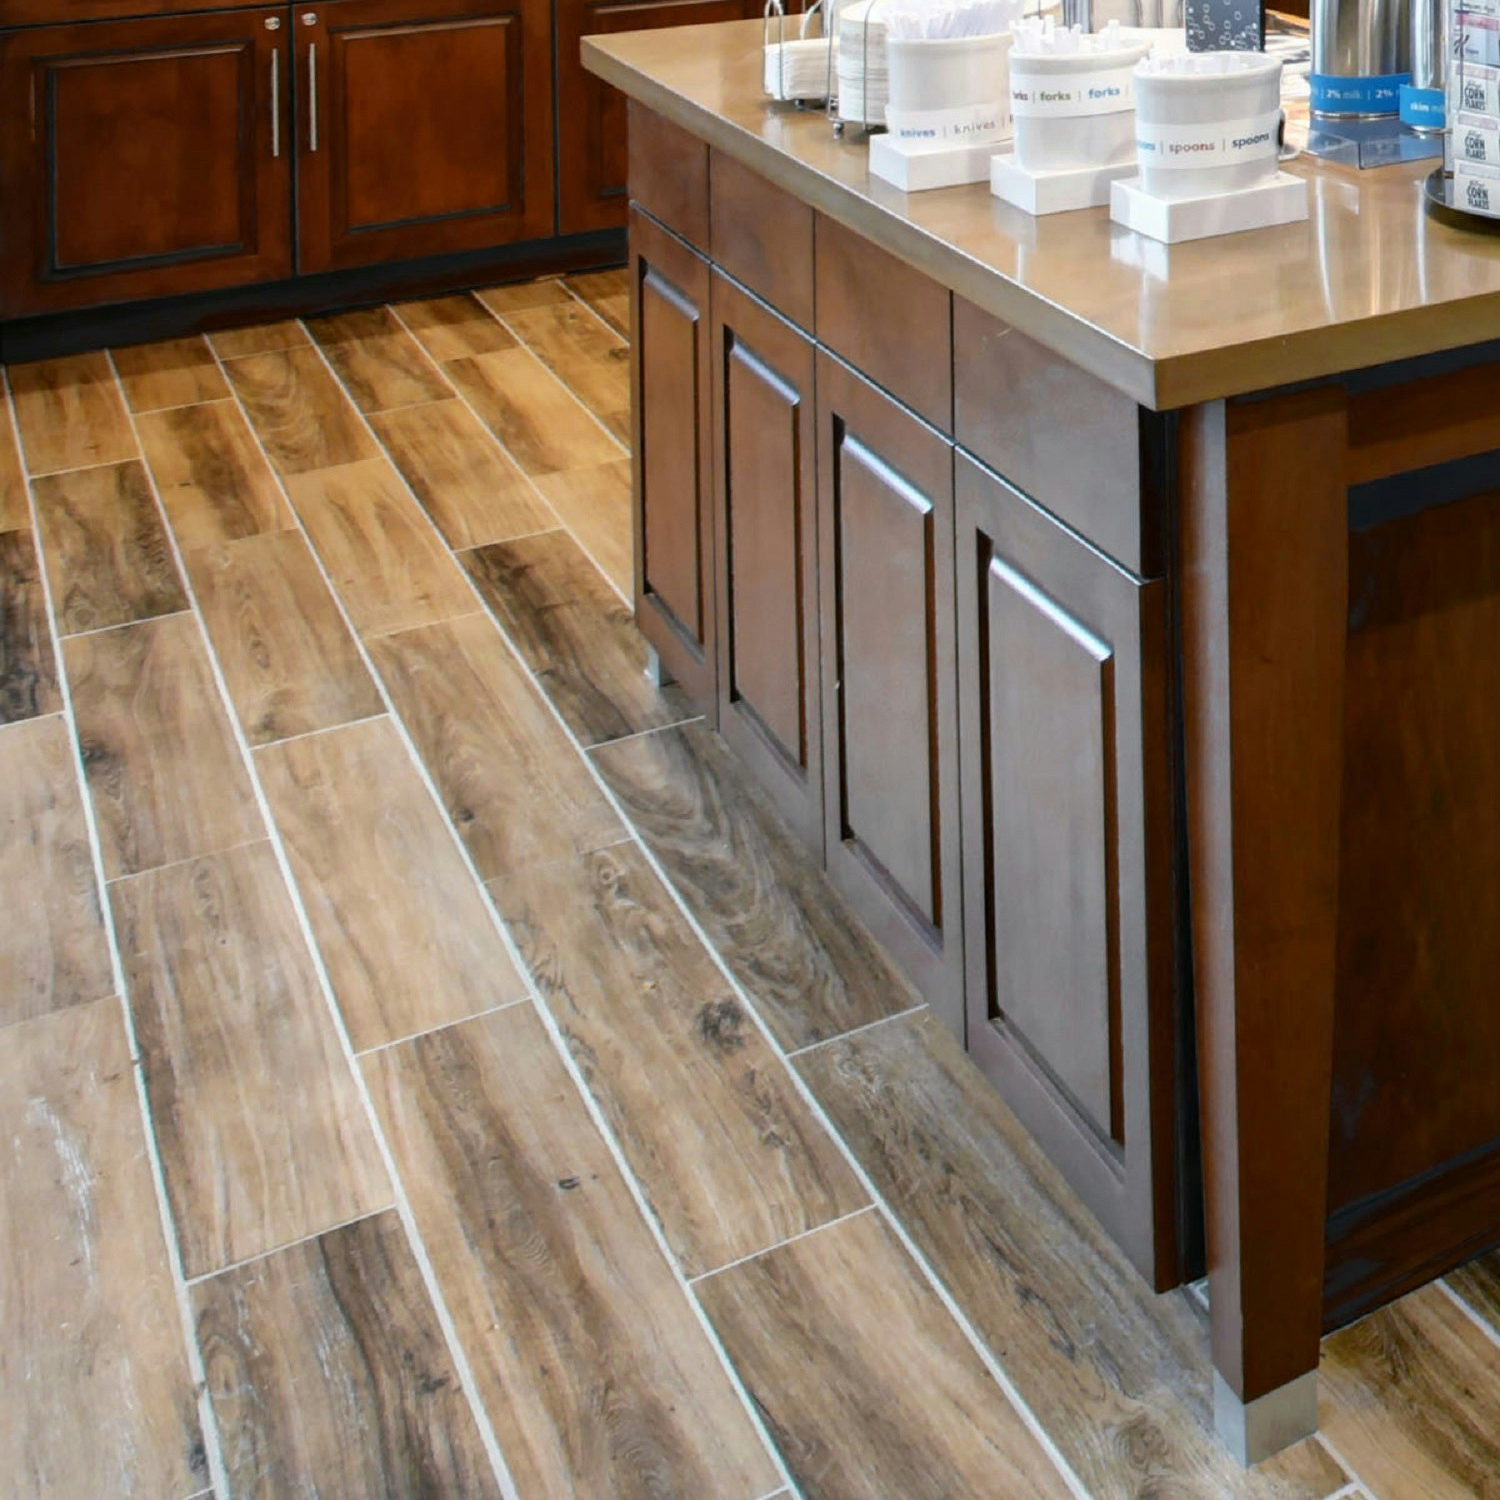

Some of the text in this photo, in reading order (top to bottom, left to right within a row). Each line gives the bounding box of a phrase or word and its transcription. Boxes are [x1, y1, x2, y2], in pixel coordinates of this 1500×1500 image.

[1040, 90, 1071, 102] forks
[1088, 86, 1120, 99] forks
[900, 120, 996, 139] knives knives
[1169, 141, 1216, 155] spoons
[1232, 132, 1270, 150] spoons
